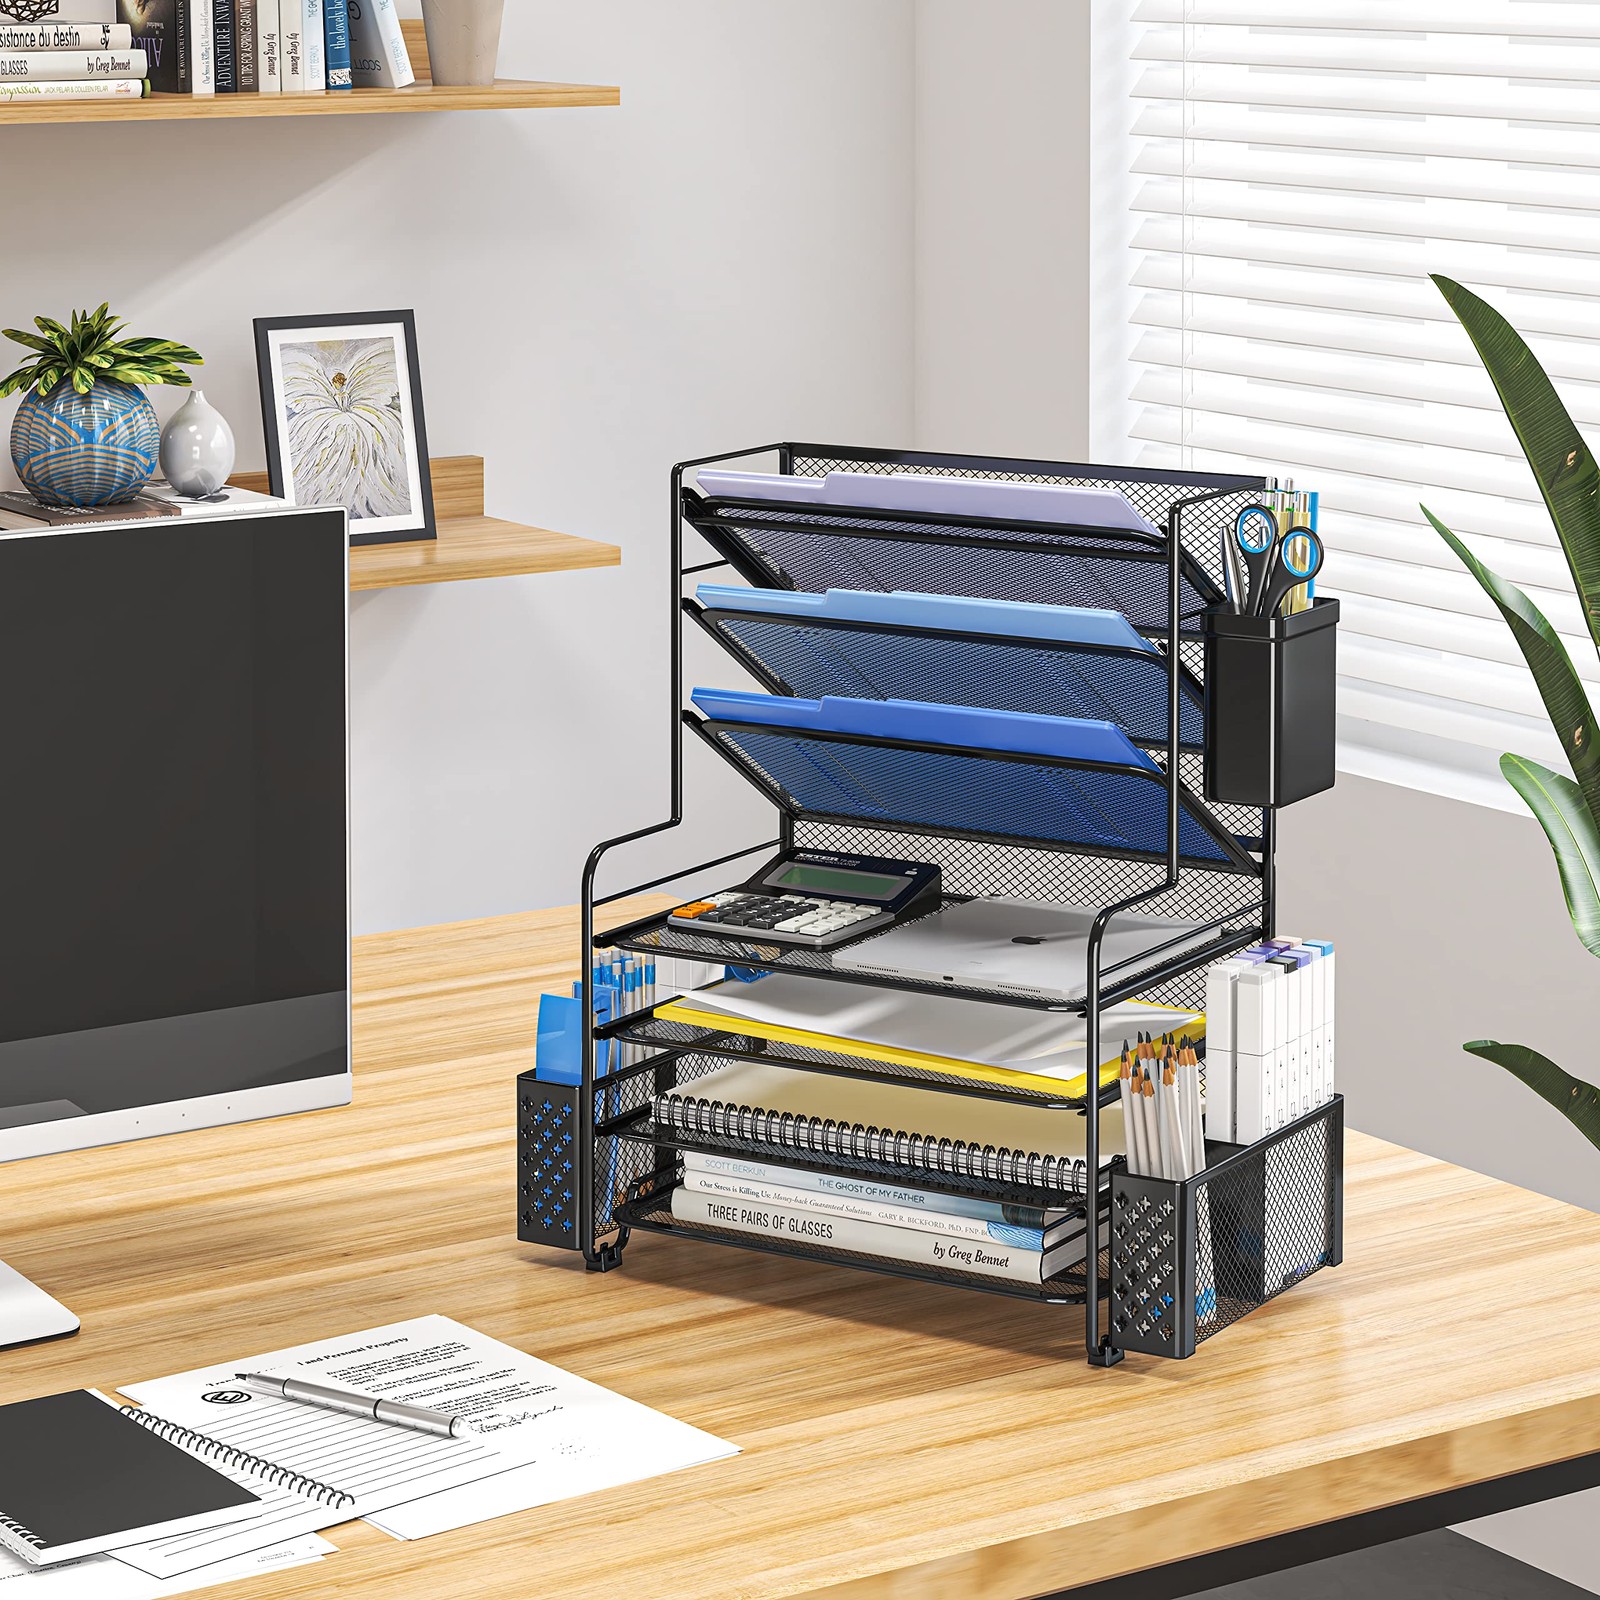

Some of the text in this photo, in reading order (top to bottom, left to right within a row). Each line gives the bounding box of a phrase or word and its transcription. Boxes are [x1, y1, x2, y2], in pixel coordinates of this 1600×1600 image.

[240, 8, 252, 27] GRANT
[328, 11, 346, 34] lovely
[39, 26, 50, 47] du
[53, 26, 80, 47] destin
[240, 27, 252, 52] ASPIRING
[329, 35, 346, 49] the
[216, 27, 232, 87] ADVENTURE
[241, 52, 253, 63] FOR
[263, 41, 276, 55] Greg
[286, 32, 300, 75] by Greg Bennet
[1, 60, 28, 75] GLASSES
[87, 57, 131, 74] by Greg Bennet
[241, 64, 253, 75] TIPS
[268, 56, 277, 76] Bennet
[354, 59, 381, 71] SCOTT
[242, 75, 253, 85] 101
[705, 1159, 925, 1204] SCOTT BERKUN THE GHOST OF MY FATHER
[700, 1180, 713, 1188] Our
[714, 1182, 731, 1192] Stress
[732, 1185, 738, 1193] is
[739, 1186, 760, 1198] Killing
[772, 1193, 808, 1206] Money-back
[809, 1199, 844, 1212] Guaranteed
[844, 1205, 872, 1216] Solutions
[878, 1212, 898, 1221] GARY
[898, 1214, 905, 1222] R.
[707, 1203, 833, 1239] THREE PAIRS OF GLASSES
[933, 1242, 1009, 1268] by Greg Bennet
[323, 1346, 366, 1360] Personal
[366, 1337, 408, 1350] Property
